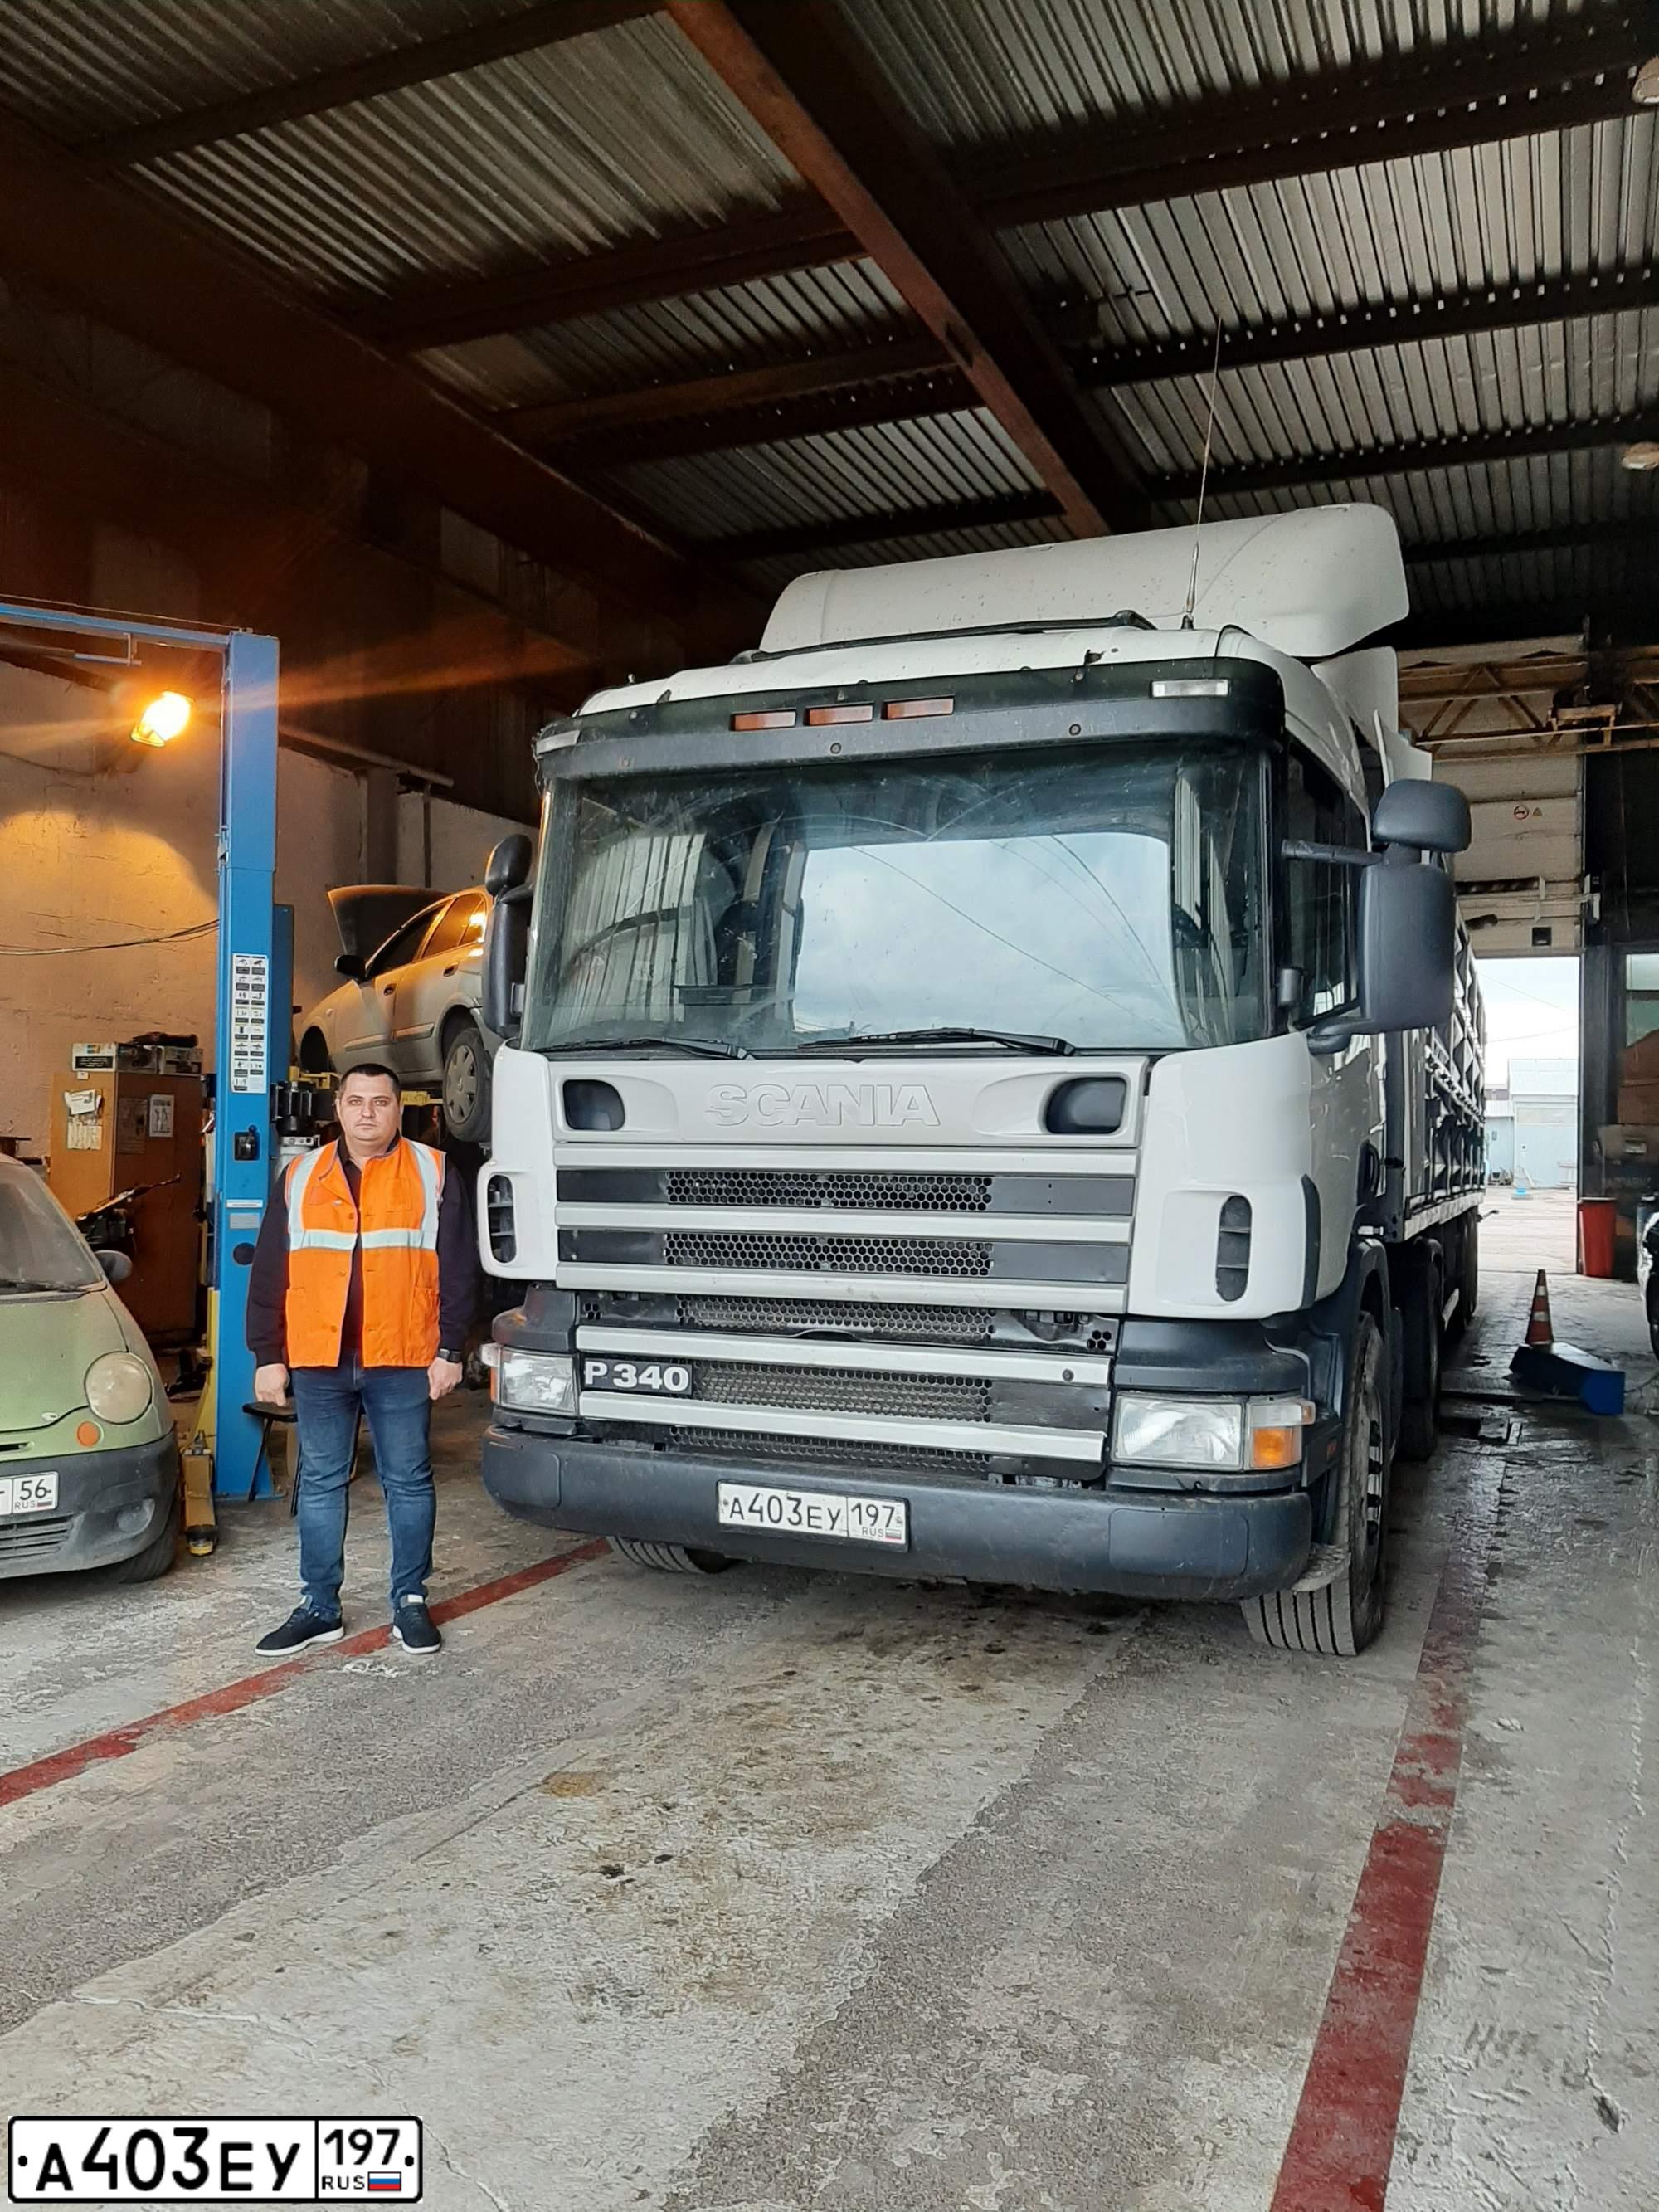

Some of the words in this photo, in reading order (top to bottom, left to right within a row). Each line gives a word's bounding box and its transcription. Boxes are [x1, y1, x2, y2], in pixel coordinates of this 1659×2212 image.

[705, 1083, 941, 1127] SCANIA
[584, 1361, 607, 1385] P
[613, 1363, 689, 1391] 340
[20, 1479, 47, 1500] 56
[14, 1500, 36, 1509] RUS
[851, 1503, 895, 1528] 197
[862, 1527, 884, 1537] RUS
